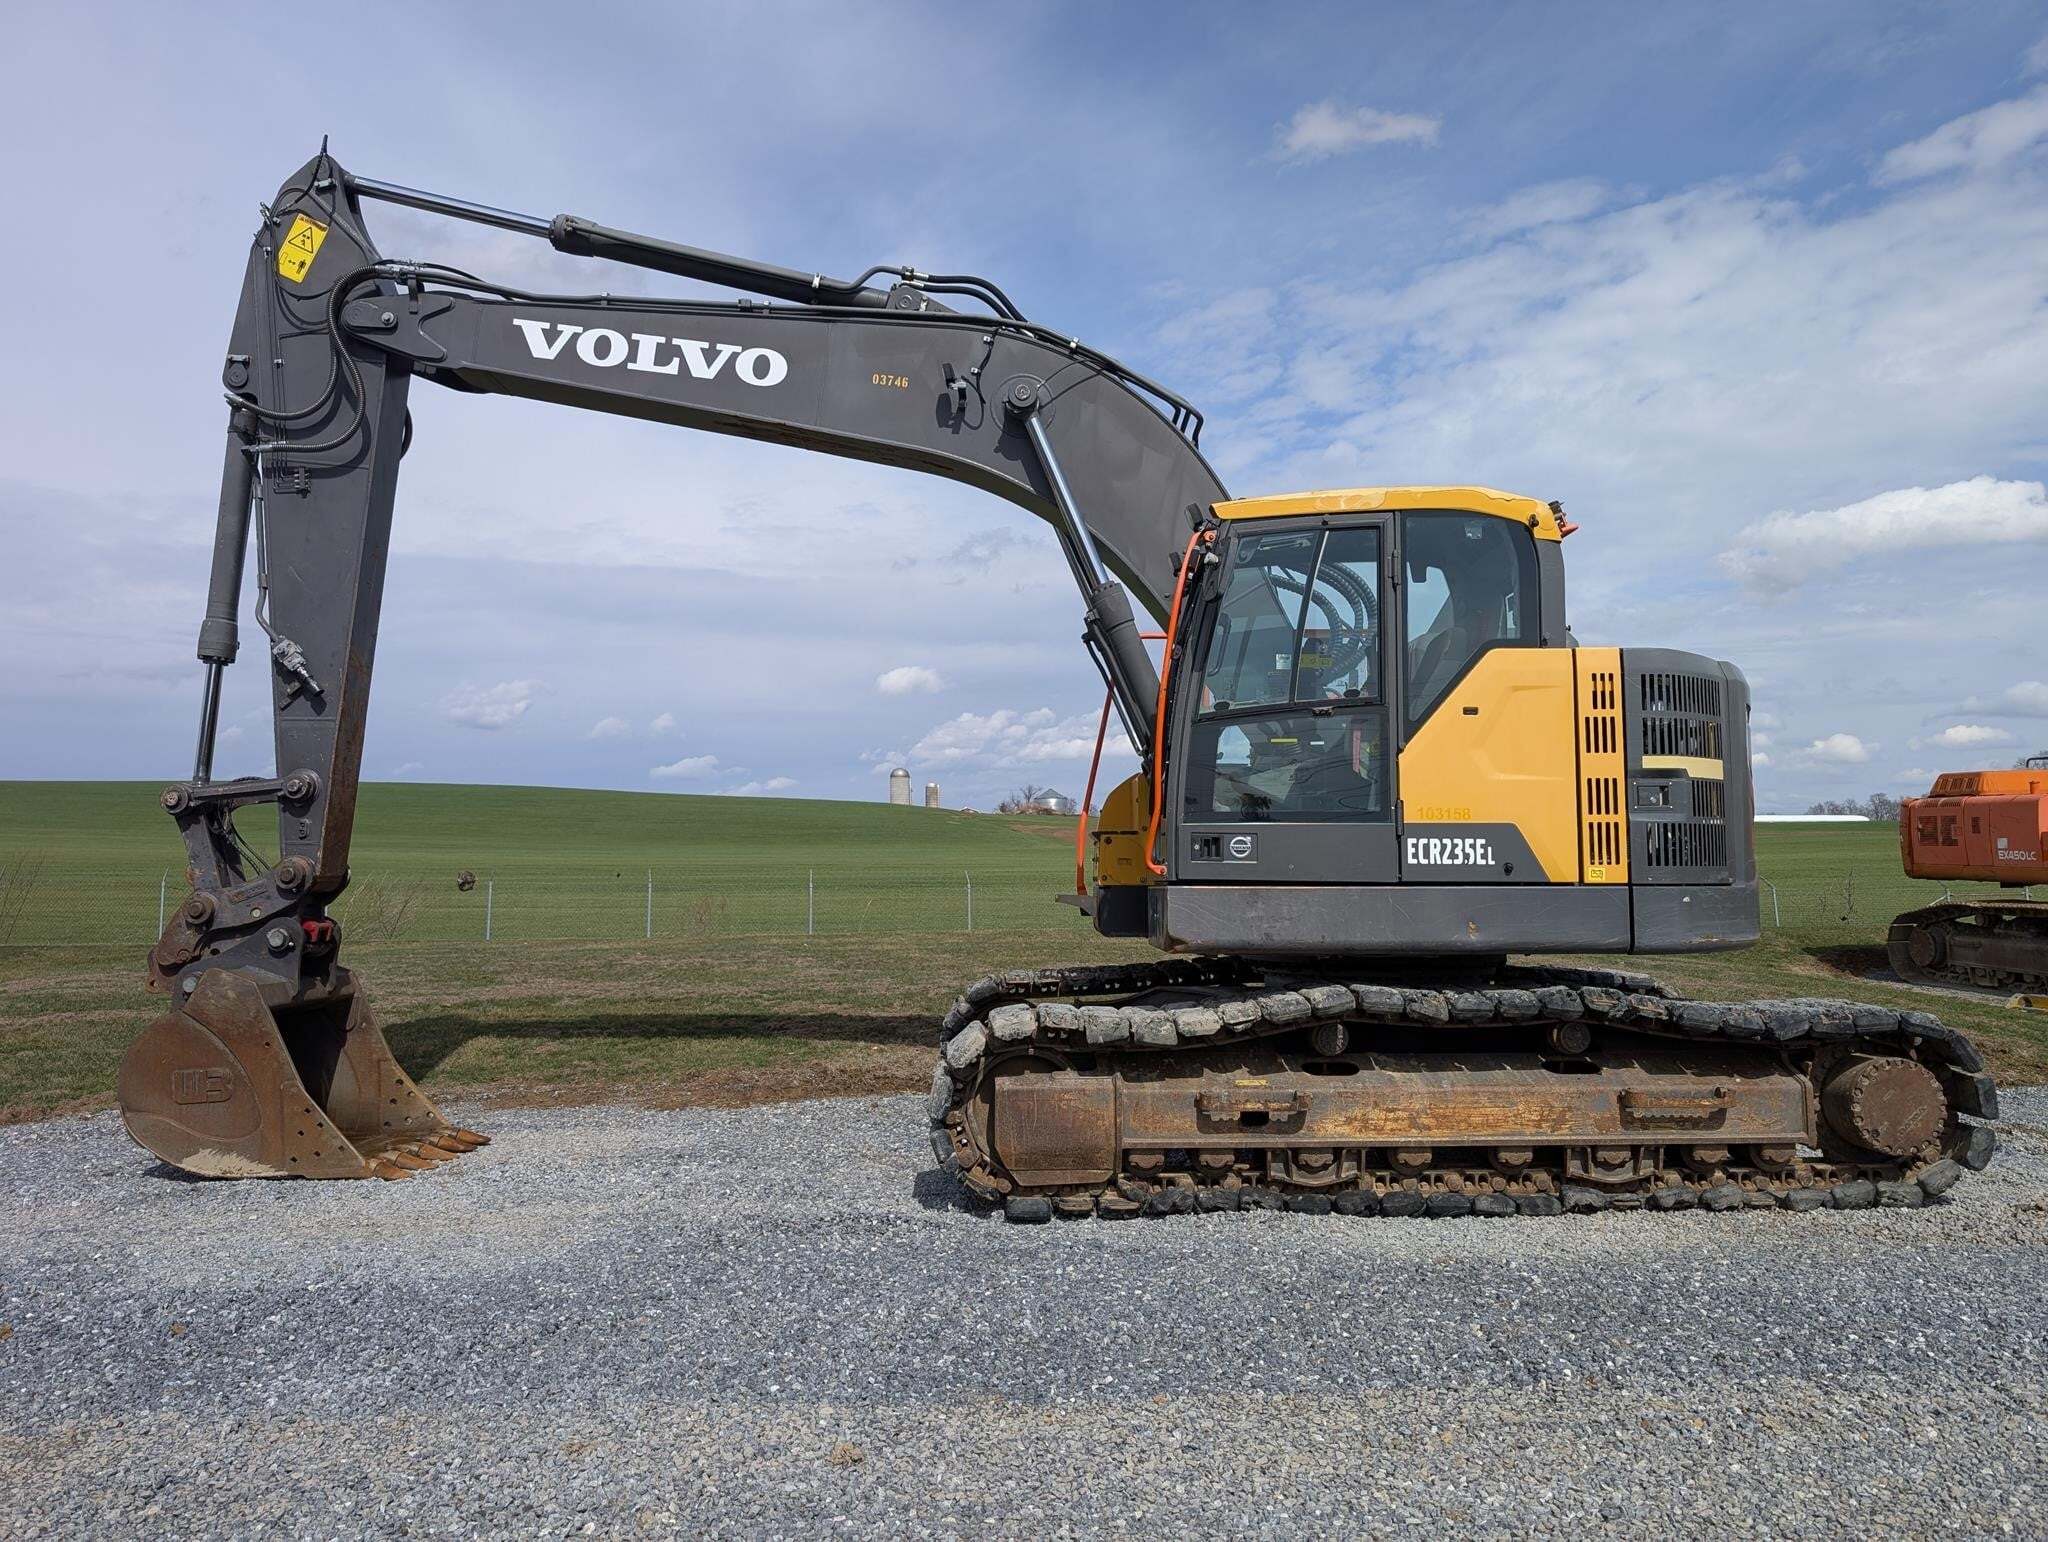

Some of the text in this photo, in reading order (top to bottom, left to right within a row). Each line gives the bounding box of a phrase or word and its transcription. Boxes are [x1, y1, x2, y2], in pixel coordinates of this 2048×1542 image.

[513, 318, 788, 387] VOLVO
[872, 373, 909, 388] 03746
[1417, 806, 1472, 820] 103158
[1406, 837, 1496, 866] ECR235EL
[1997, 850, 2037, 861] EX450LC
